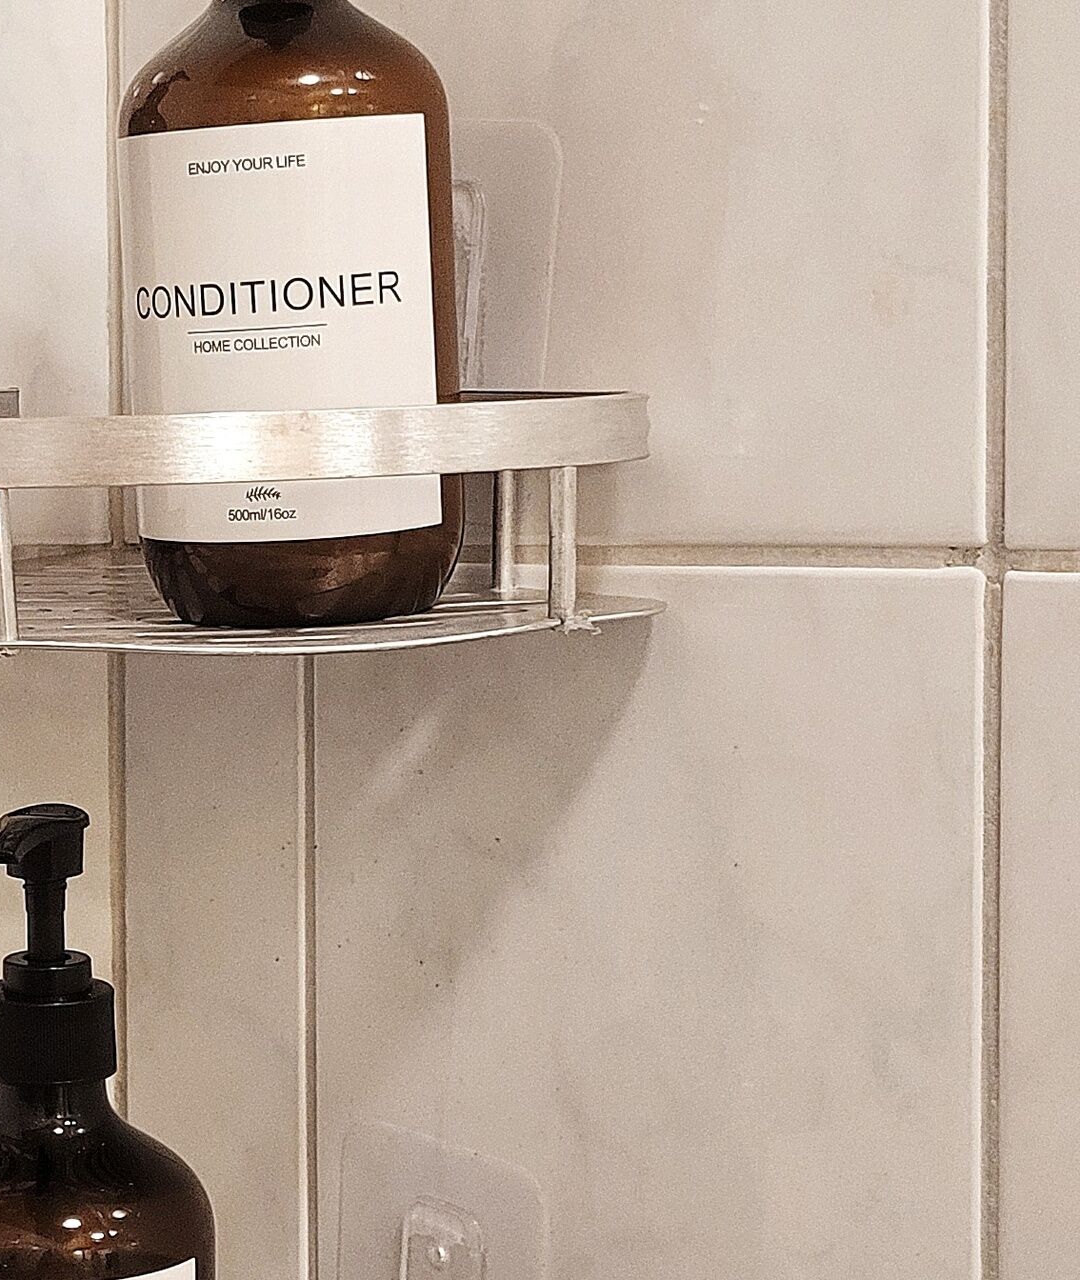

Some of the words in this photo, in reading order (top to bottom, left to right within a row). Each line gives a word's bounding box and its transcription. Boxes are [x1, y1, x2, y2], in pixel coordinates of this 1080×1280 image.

[188, 158, 230, 176] ENJOY
[232, 157, 274, 172] YOUR
[275, 154, 306, 169] LIFE
[136, 270, 402, 320] CONDITIONER
[193, 338, 231, 354] HOME
[233, 334, 321, 351] COLLECTION
[228, 507, 297, 522] 500ml/16oz
